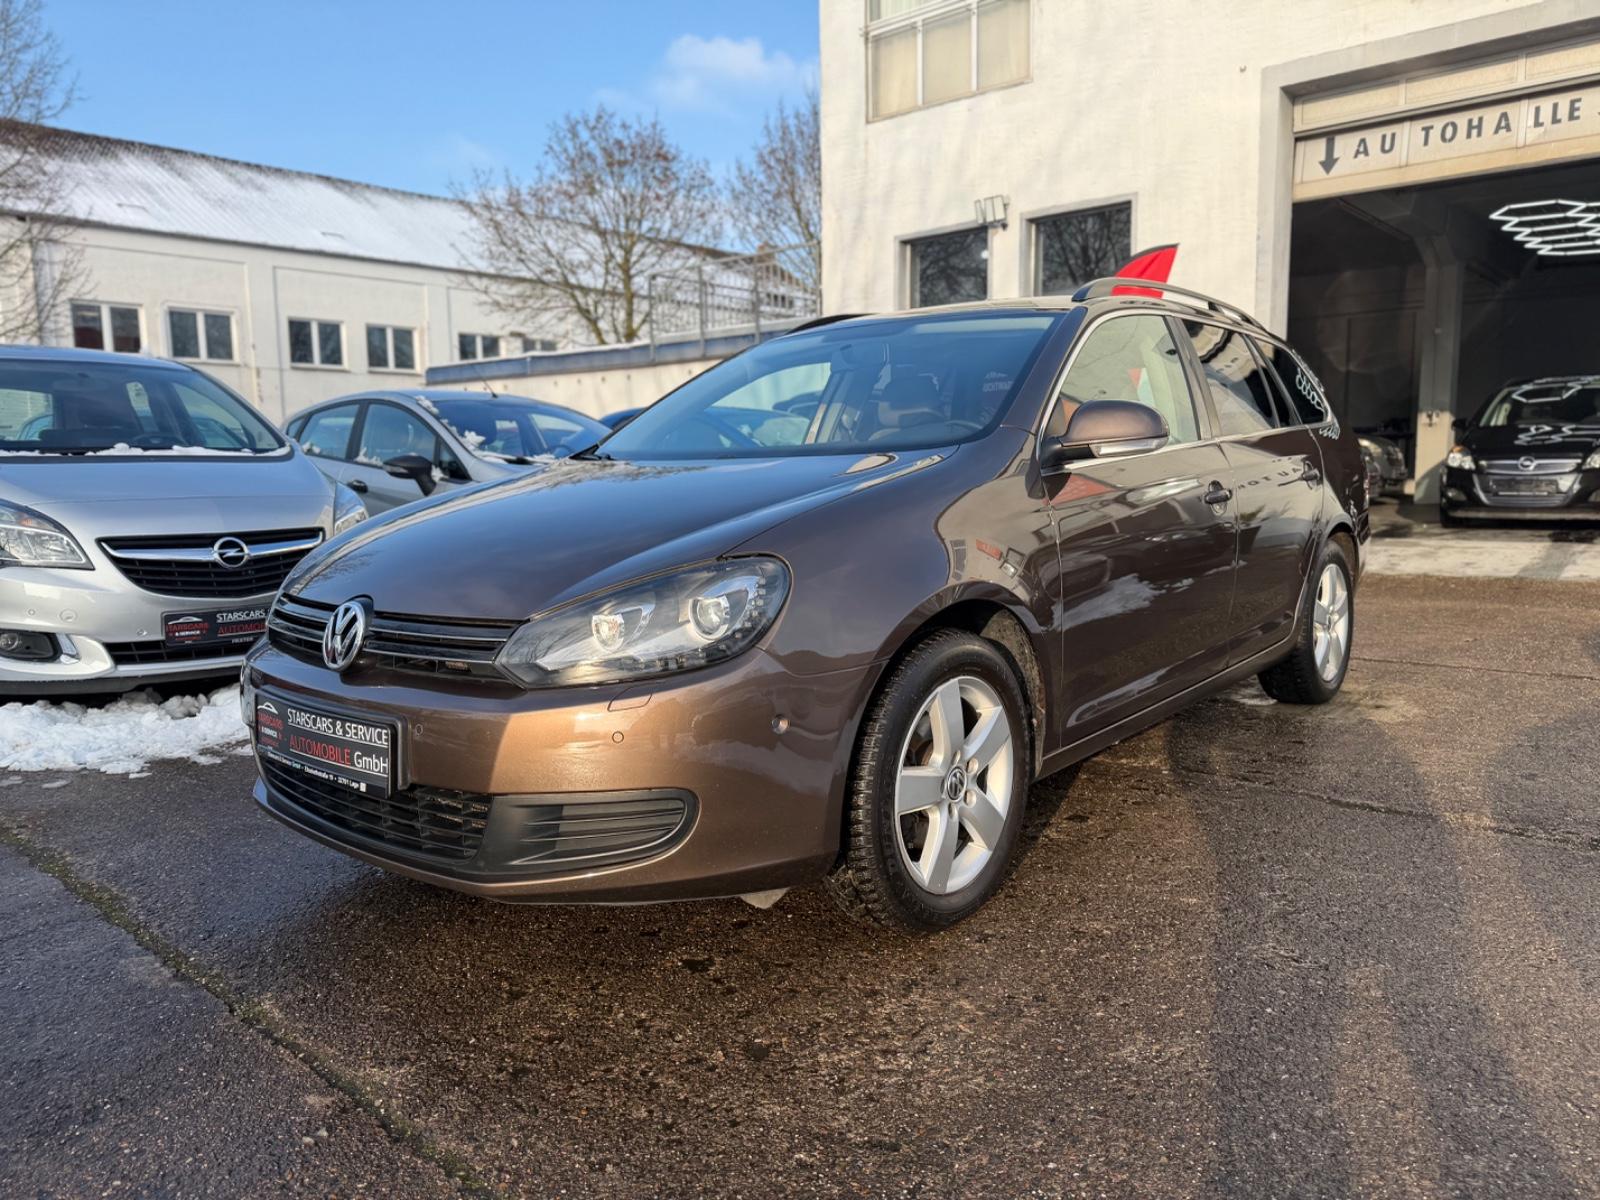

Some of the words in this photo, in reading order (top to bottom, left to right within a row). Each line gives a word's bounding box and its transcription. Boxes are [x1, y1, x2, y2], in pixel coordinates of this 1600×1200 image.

[216, 609, 266, 621] STARSCARS
[287, 708, 334, 733] STARSCARS
[335, 720, 343, 736] &
[345, 722, 389, 745] SERVICE
[289, 734, 351, 766] AUTOMOBILE
[353, 751, 389, 774] GmbH
